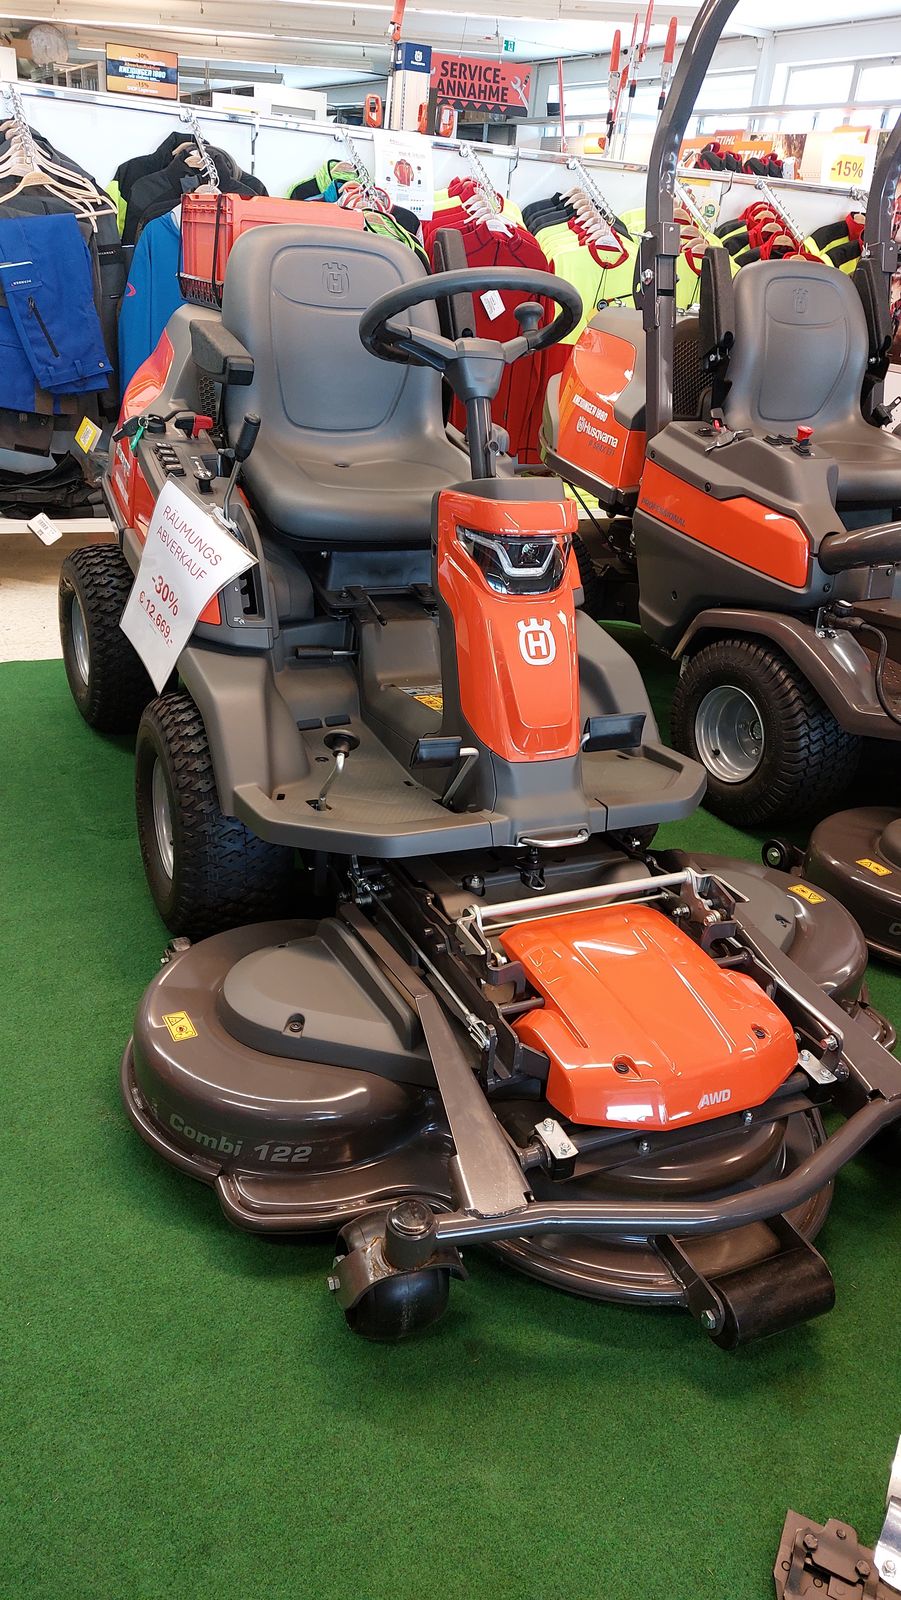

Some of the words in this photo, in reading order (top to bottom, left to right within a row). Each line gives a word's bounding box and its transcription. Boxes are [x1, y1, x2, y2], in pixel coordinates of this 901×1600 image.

[441, 60, 506, 84] SERVICE-
[437, 78, 509, 103] ANNAHME
[715, 135, 736, 145] STIHL
[831, 160, 864, 178] -15%
[583, 420, 619, 448] Husqvarna
[163, 505, 222, 567] RÄUMUNGS
[156, 525, 208, 581] ABVERKAUF
[139, 590, 146, 604] €
[151, 575, 179, 617] -30%
[697, 1089, 731, 1110] AWD
[169, 1113, 243, 1157] Combi
[254, 1144, 313, 1163] 122
